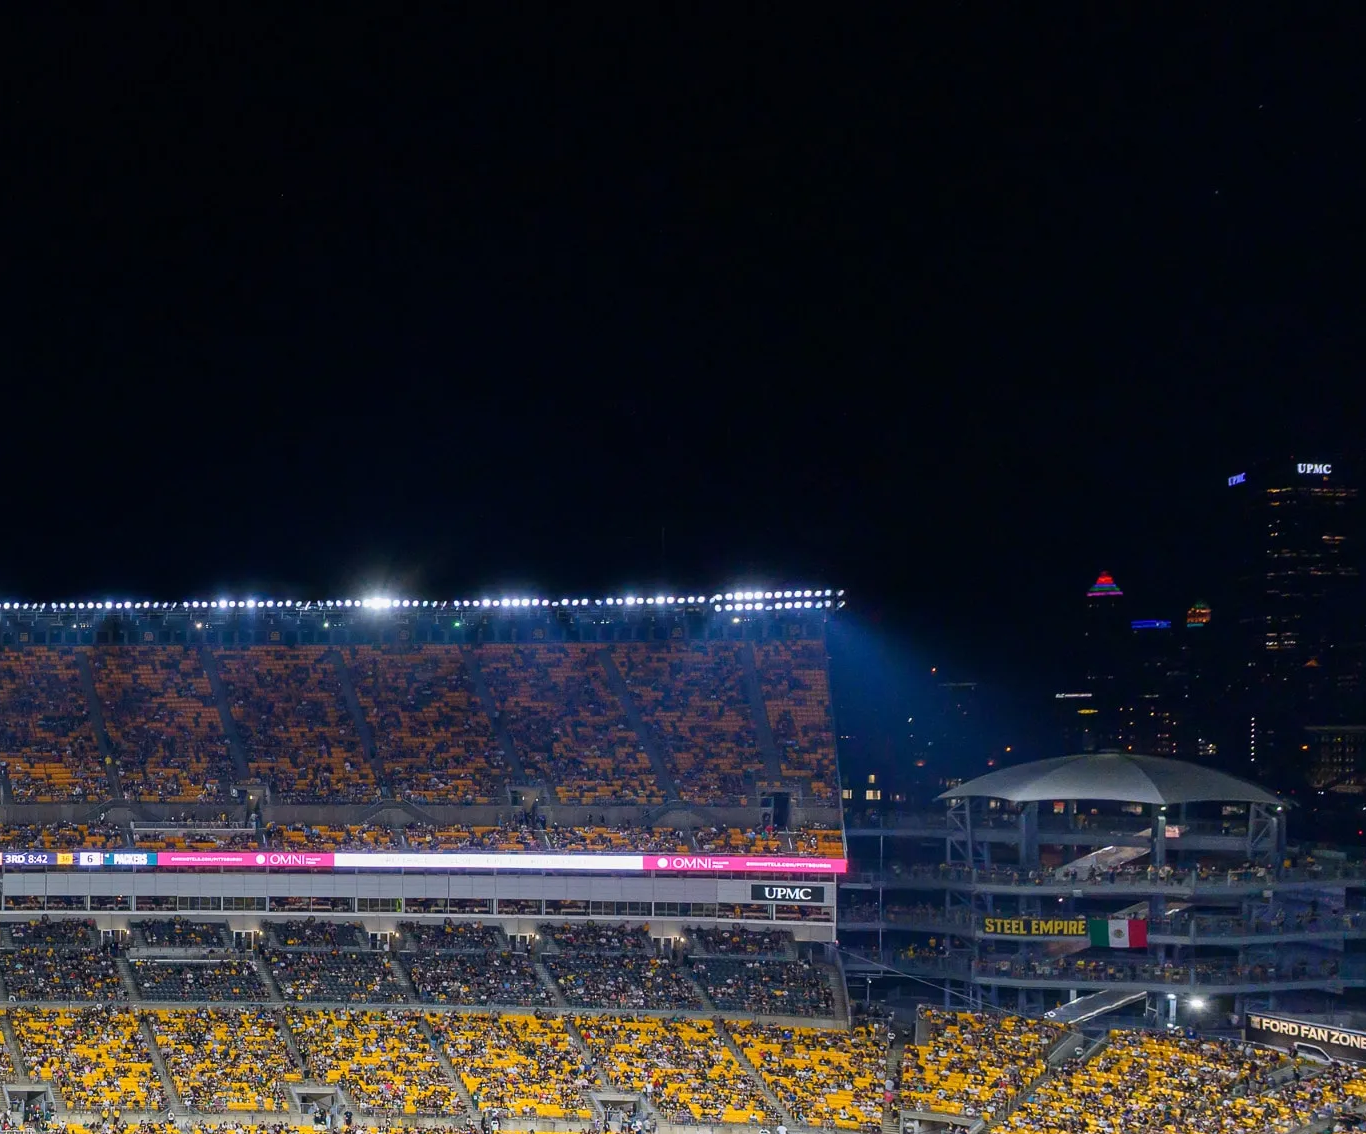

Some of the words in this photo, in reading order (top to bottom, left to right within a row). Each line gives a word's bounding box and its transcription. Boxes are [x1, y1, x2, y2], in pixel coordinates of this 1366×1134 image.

[1296, 463, 1332, 475] UPMC
[5, 853, 26, 864] 3RD
[28, 853, 48, 865] 8:42
[87, 855, 93, 863] 6
[269, 854, 305, 865] OMNI
[672, 857, 712, 869] OMNI
[764, 886, 812, 900] UPMC
[985, 918, 1027, 935] STEEL
[1031, 920, 1086, 935] EMPIRE
[1261, 1019, 1299, 1037] FORD
[1300, 1026, 1328, 1041] FAN
